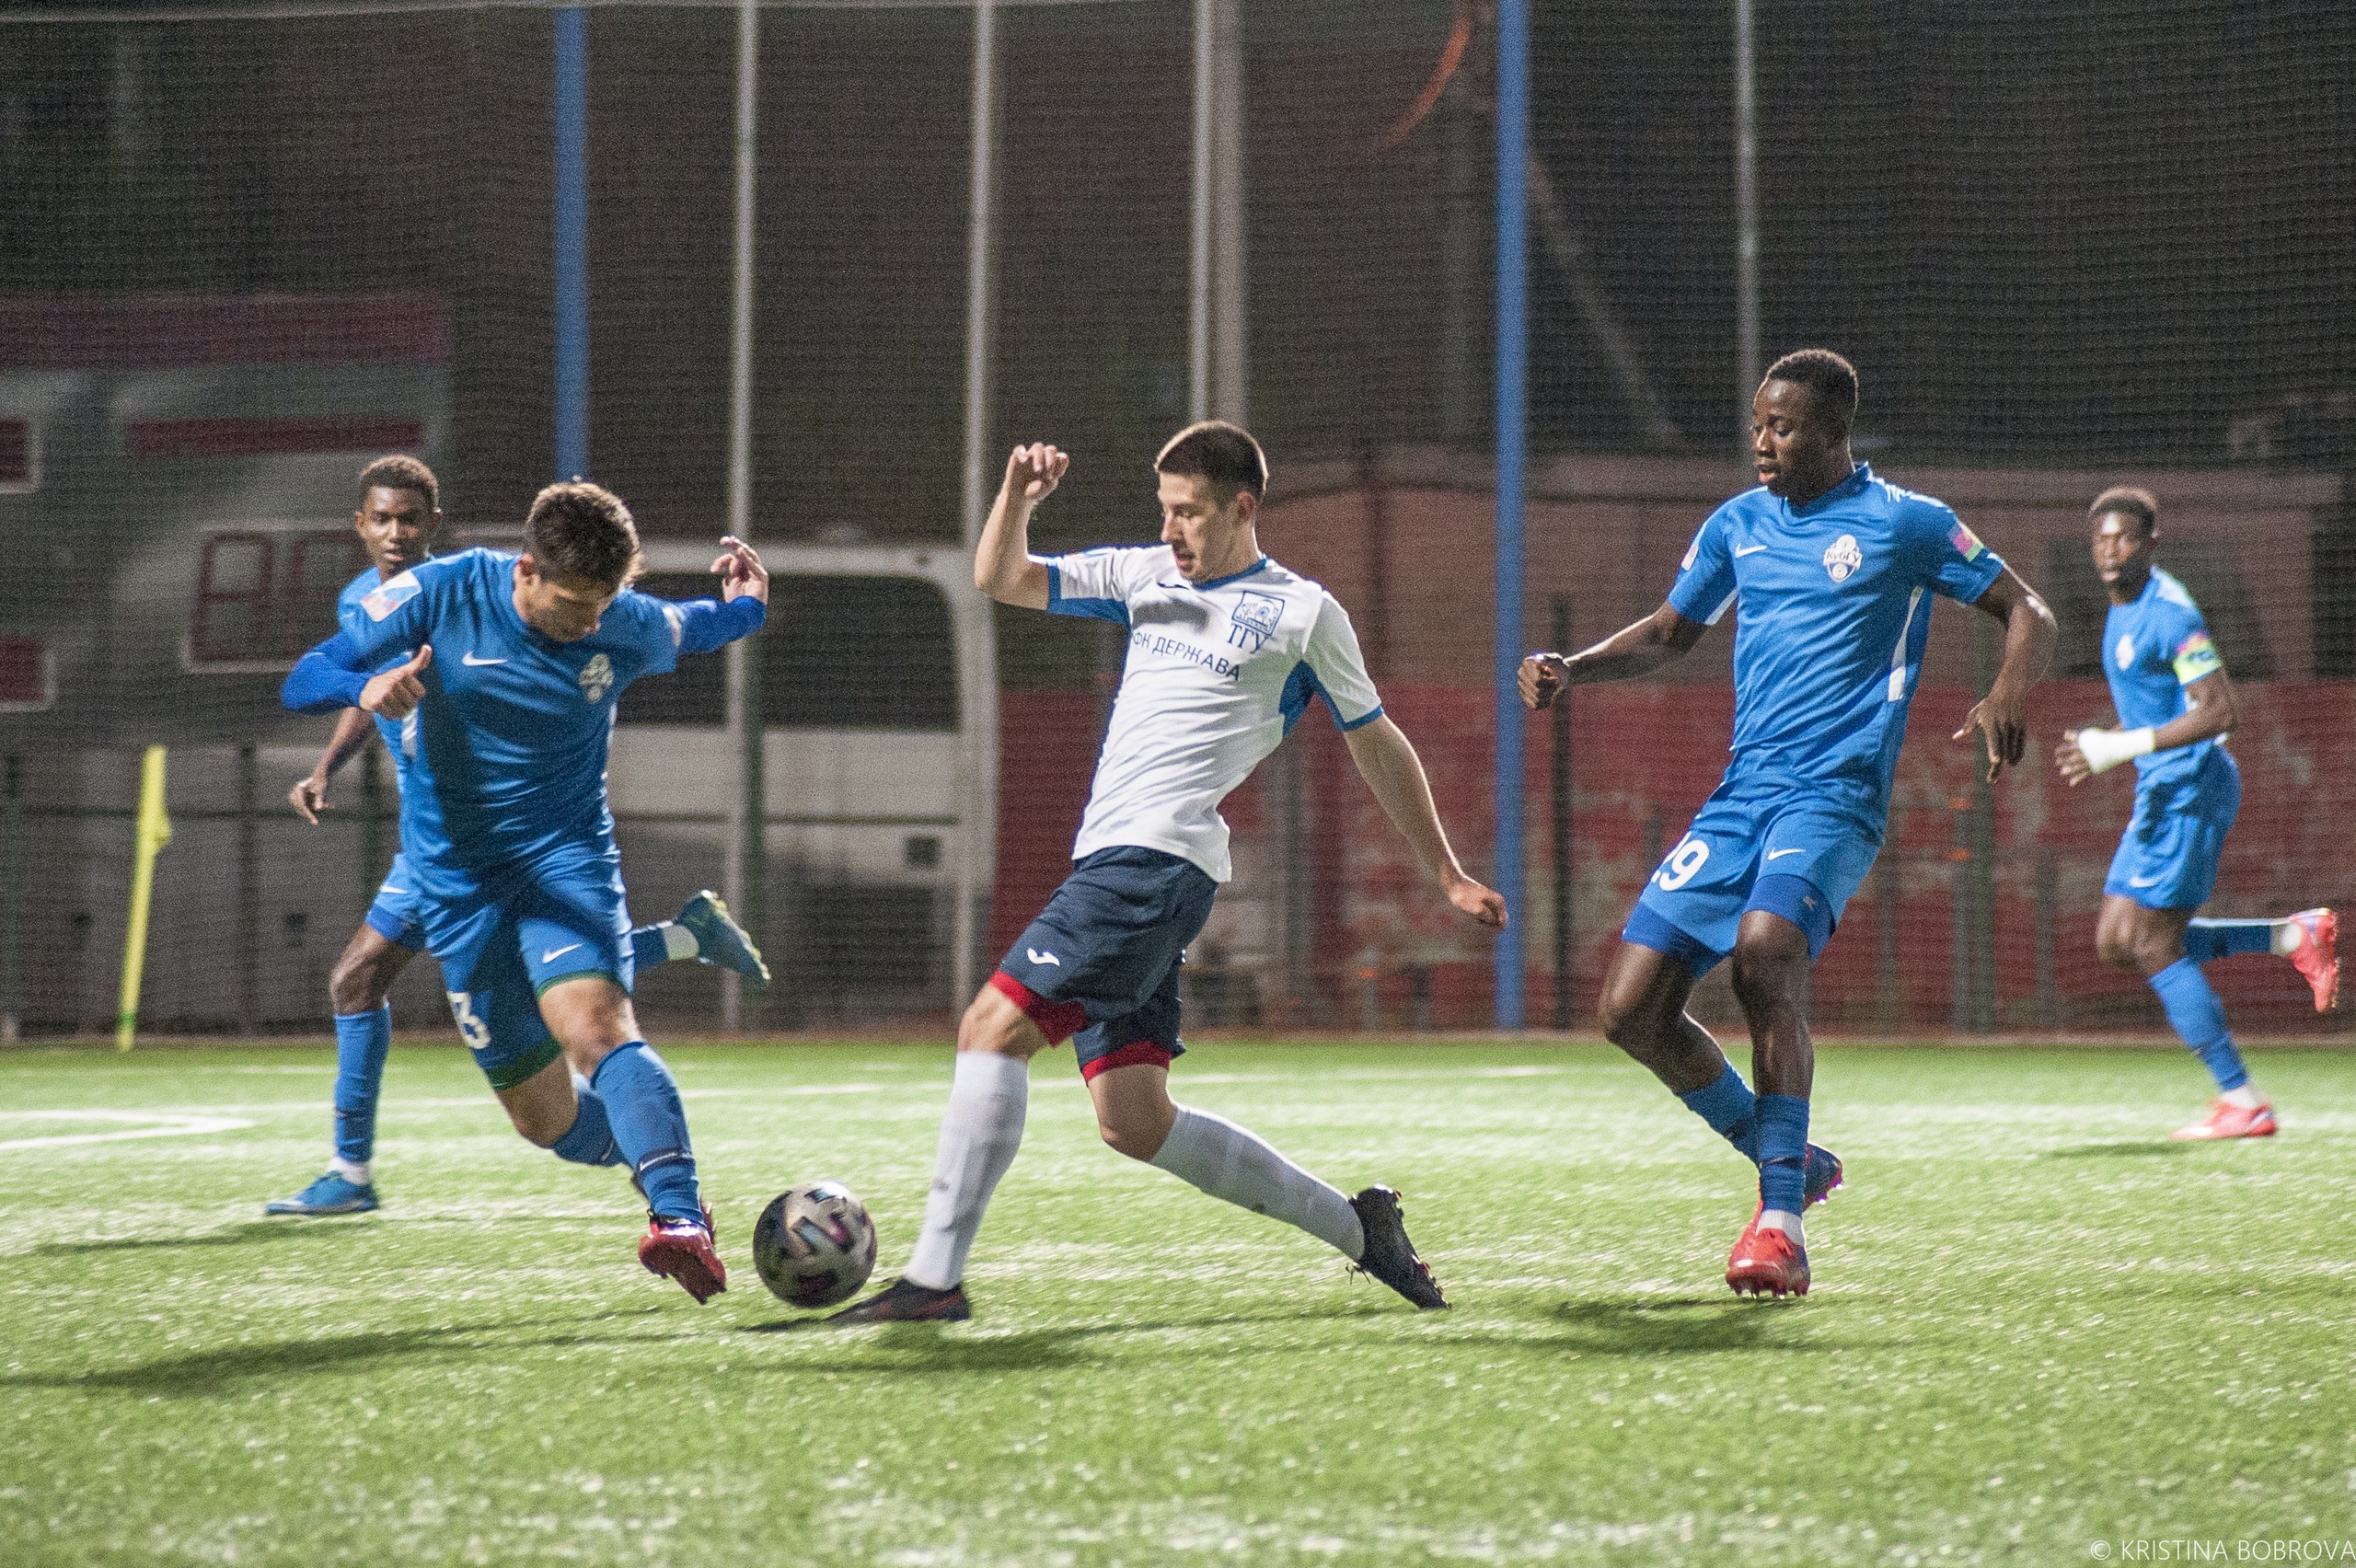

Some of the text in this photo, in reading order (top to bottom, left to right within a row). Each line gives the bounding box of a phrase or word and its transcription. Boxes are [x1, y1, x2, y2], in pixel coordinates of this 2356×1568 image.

[1133, 632, 1241, 681] ФК ДЕРЖАВА
[1227, 623, 1269, 654] ТГУ
